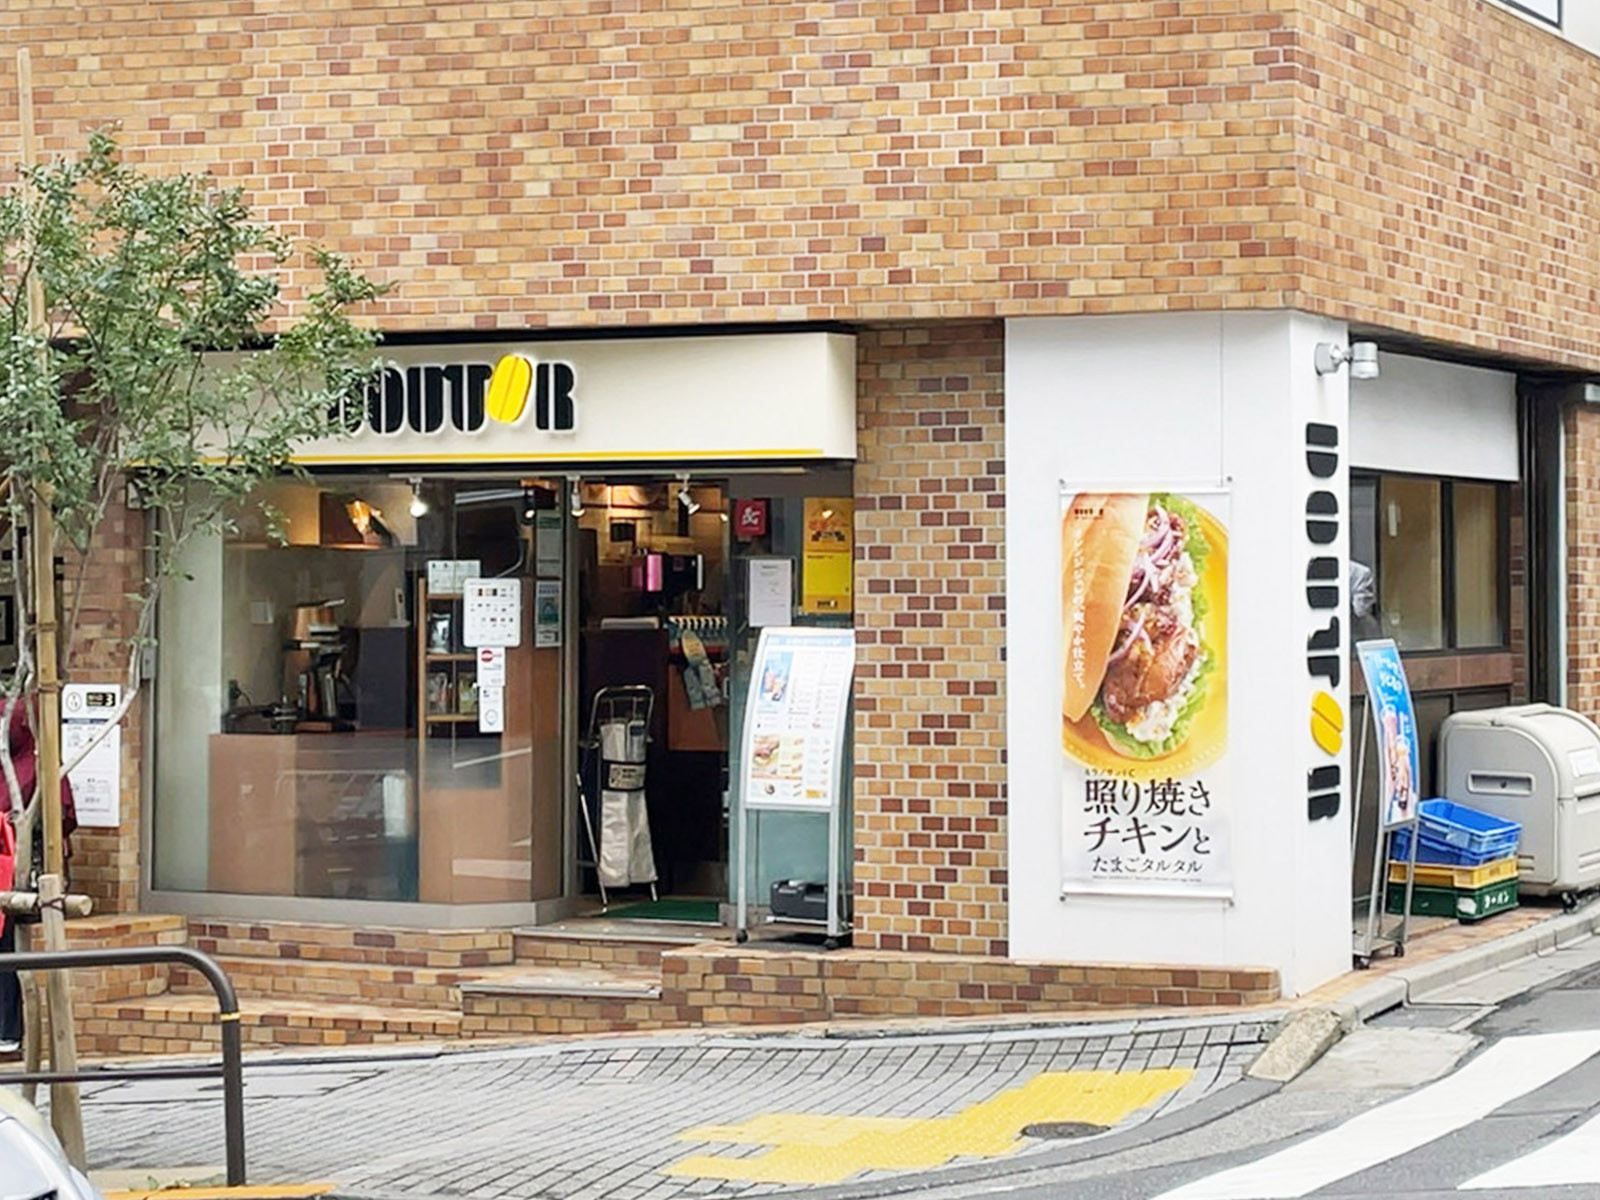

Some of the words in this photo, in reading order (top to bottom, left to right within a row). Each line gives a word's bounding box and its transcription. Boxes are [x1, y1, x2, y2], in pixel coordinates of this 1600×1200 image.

[1305, 421, 1344, 822] DOUTOR
[1083, 777, 1211, 816] 照り焼き
[1083, 816, 1211, 854] チキンと
[1092, 856, 1203, 873] たまごタルタル
